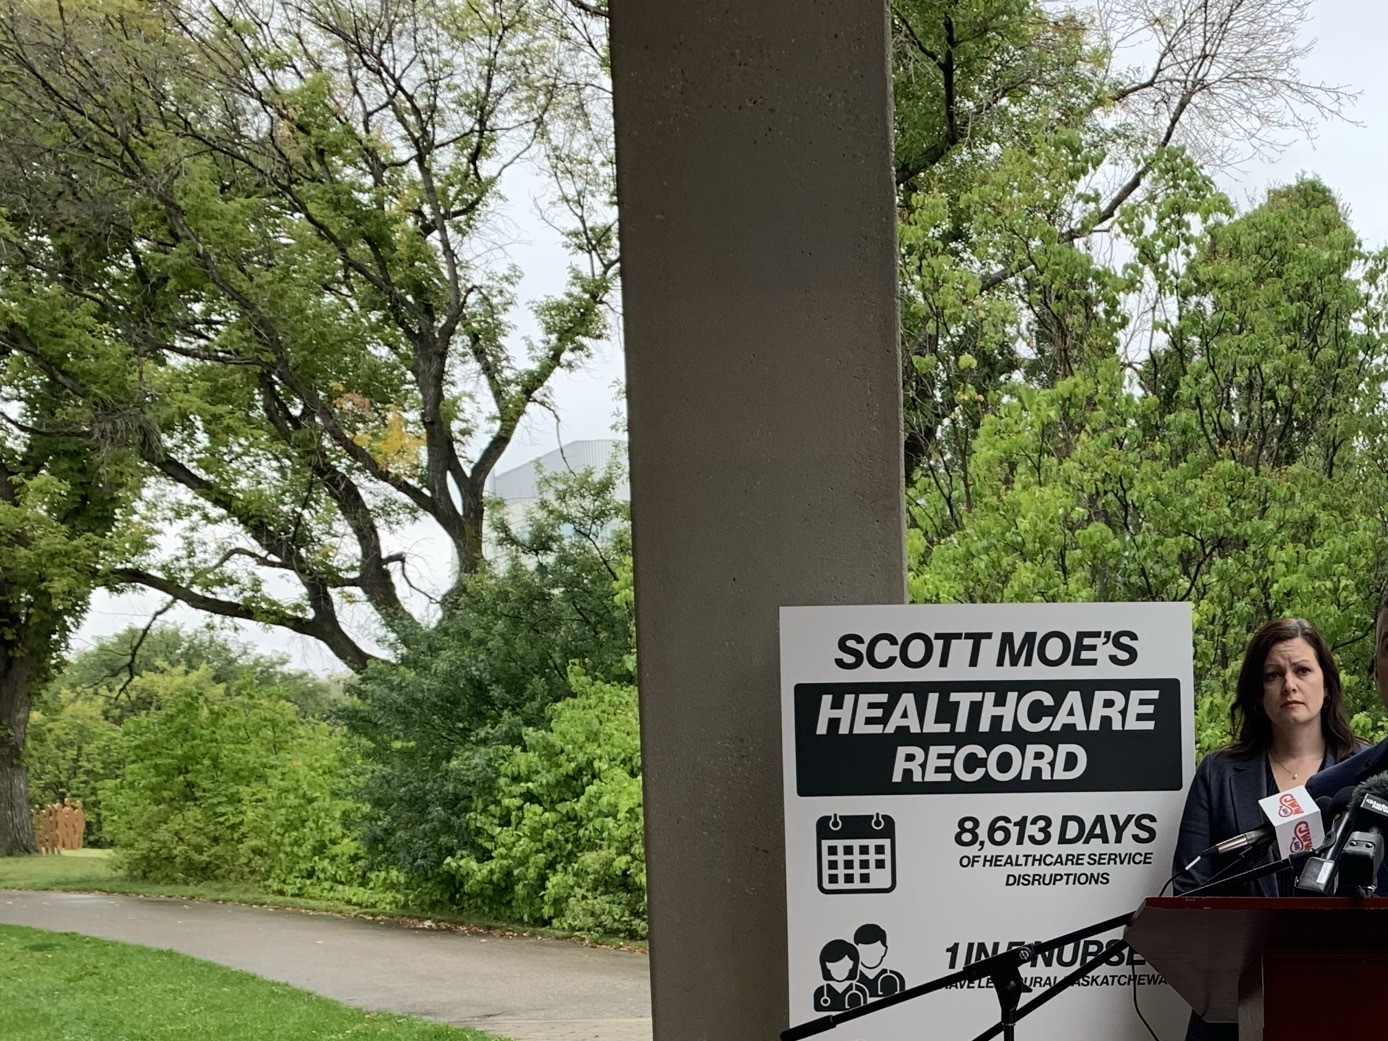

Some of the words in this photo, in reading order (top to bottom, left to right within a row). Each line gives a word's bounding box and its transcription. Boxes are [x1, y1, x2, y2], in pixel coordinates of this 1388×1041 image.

[835, 632, 992, 670] SCOTT
[996, 630, 1138, 667] MOE'S
[816, 690, 1159, 734] HEALTHCARE
[892, 744, 1087, 782] RECORD
[955, 815, 1052, 851] 8,613
[1058, 814, 1157, 844] DAYS
[959, 855, 981, 868] OF
[983, 854, 1085, 867] HEALTHCARE
[1087, 852, 1153, 865] SERVICE
[1006, 873, 1109, 886] DISRUPTIONS
[945, 942, 959, 970] 1
[1030, 939, 1147, 968] NURSE
[1070, 974, 1168, 987] ASKATCHEWA
